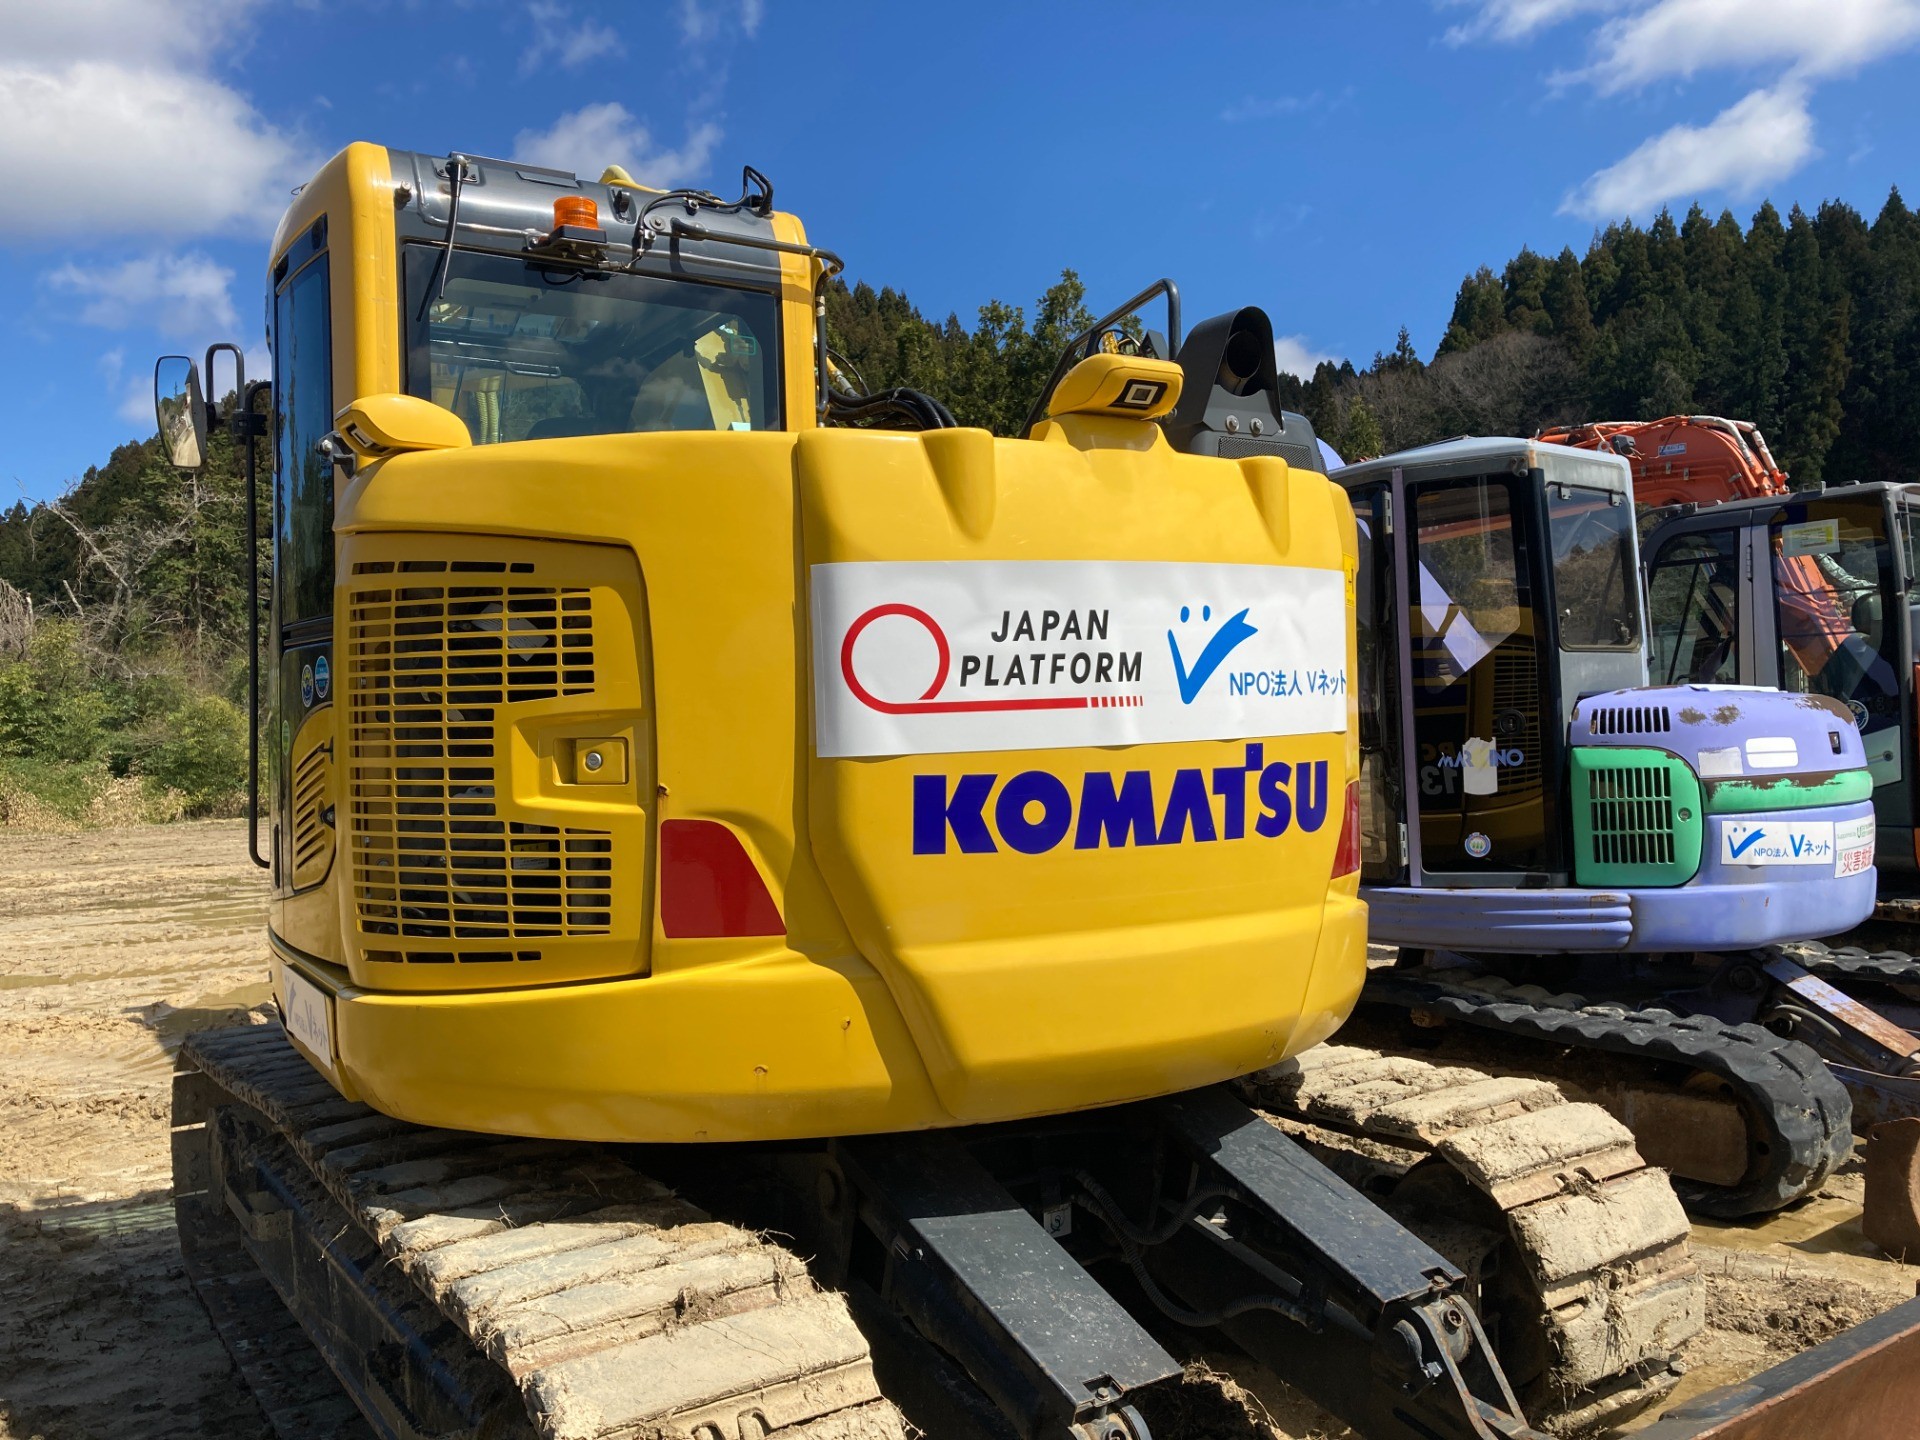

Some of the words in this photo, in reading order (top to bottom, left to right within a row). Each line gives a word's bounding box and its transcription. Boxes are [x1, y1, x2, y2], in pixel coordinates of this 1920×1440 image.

[991, 609, 1109, 643] JAPAN
[960, 652, 1143, 687] PLATFORM
[1229, 669, 1303, 697] NPO法人
[1307, 668, 1347, 695] Vネット
[913, 743, 1328, 855] KOMATSU
[1753, 847, 1789, 858] NPO法人
[1789, 833, 1831, 858] Vネット
